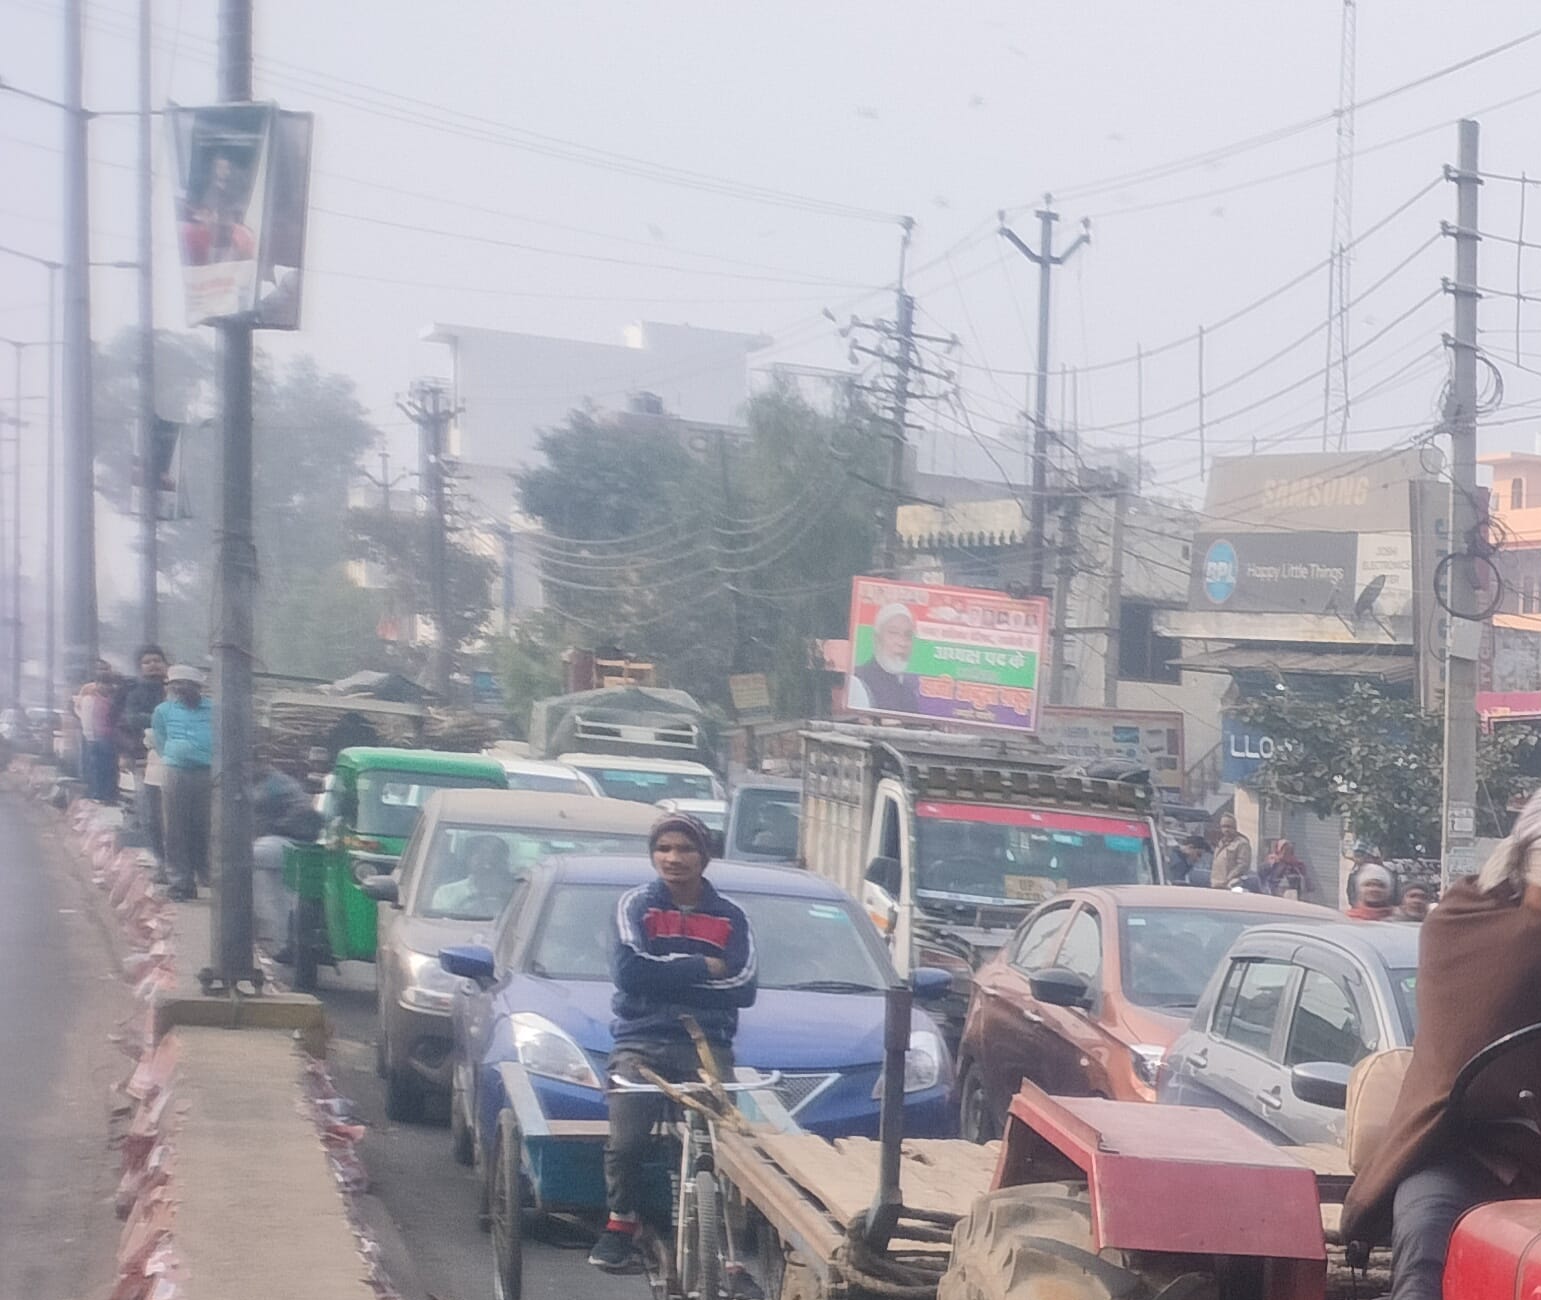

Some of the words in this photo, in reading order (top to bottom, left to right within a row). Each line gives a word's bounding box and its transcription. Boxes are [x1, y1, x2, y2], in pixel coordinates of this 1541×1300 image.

[1263, 477, 1370, 508] SAMSUNG
[1248, 566, 1281, 583] Happy
[1283, 562, 1308, 572] Little
[1309, 561, 1345, 584] Things
[984, 651, 1007, 666] पद
[1008, 650, 1026, 669] के
